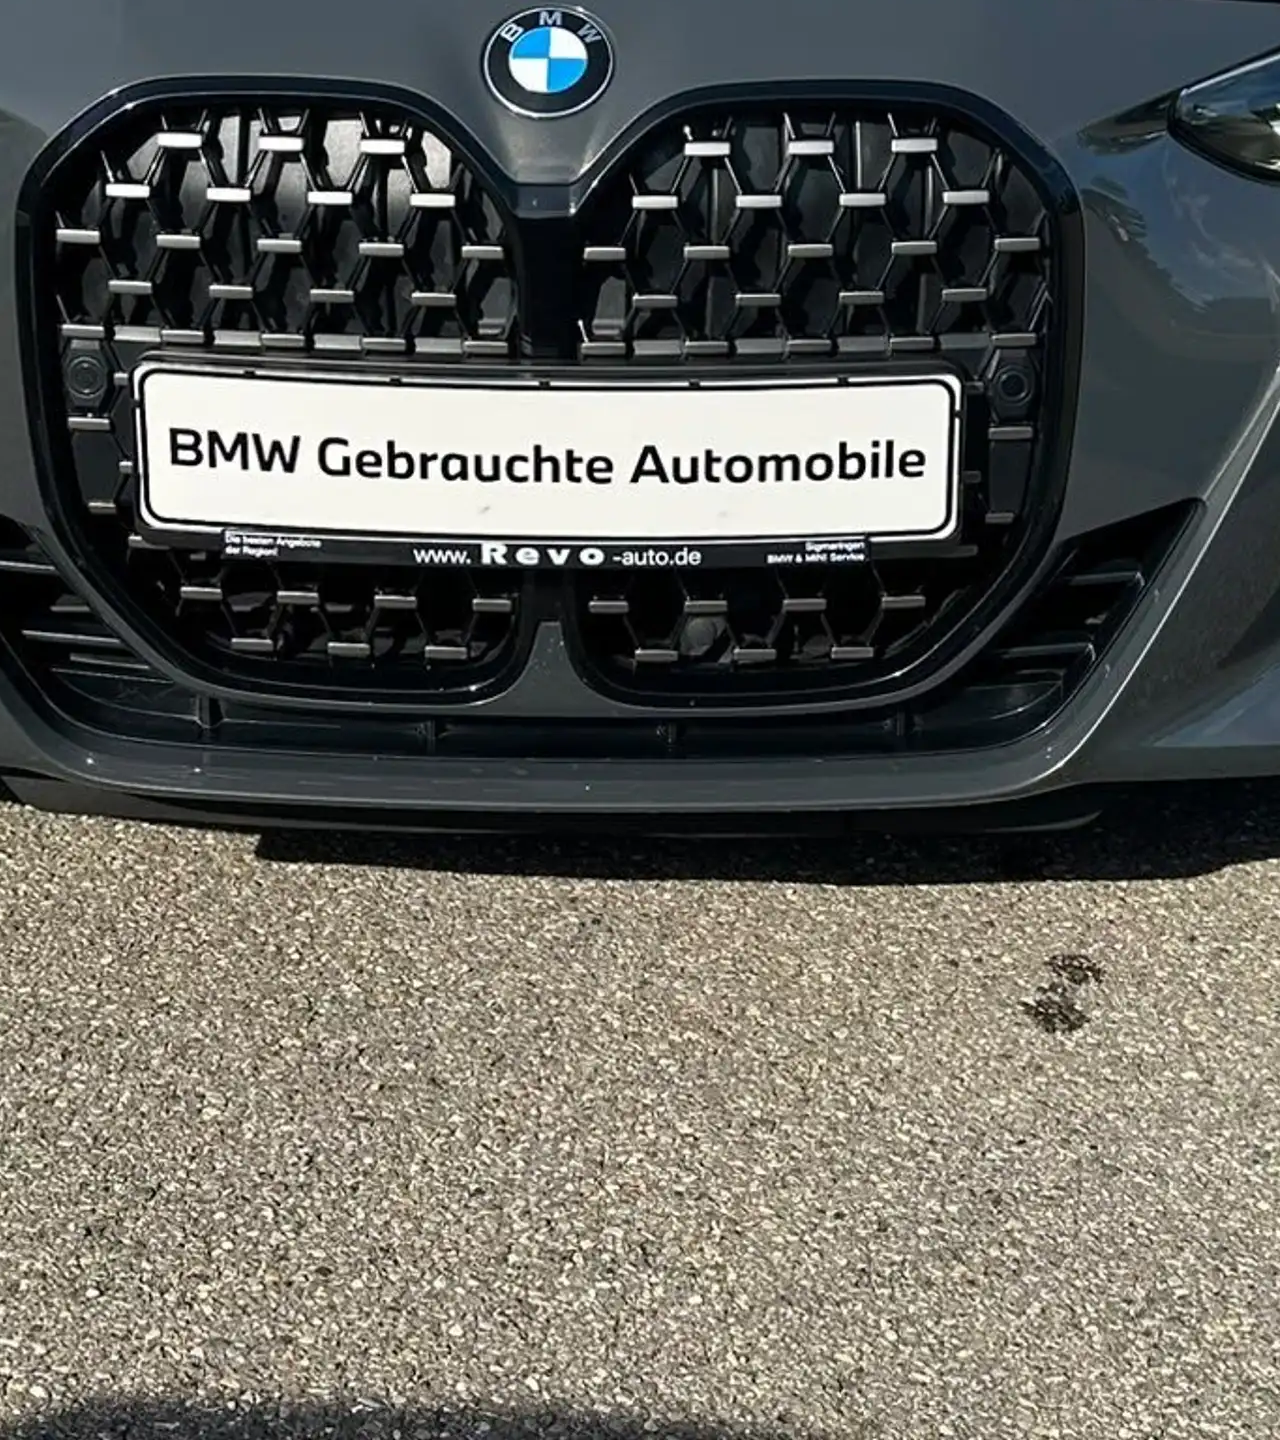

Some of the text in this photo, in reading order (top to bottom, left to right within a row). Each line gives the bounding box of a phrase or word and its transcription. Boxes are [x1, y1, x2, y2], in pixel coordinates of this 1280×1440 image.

[500, 10, 602, 44] BMW
[169, 427, 927, 484] BMW Gebrauchte Automobile
